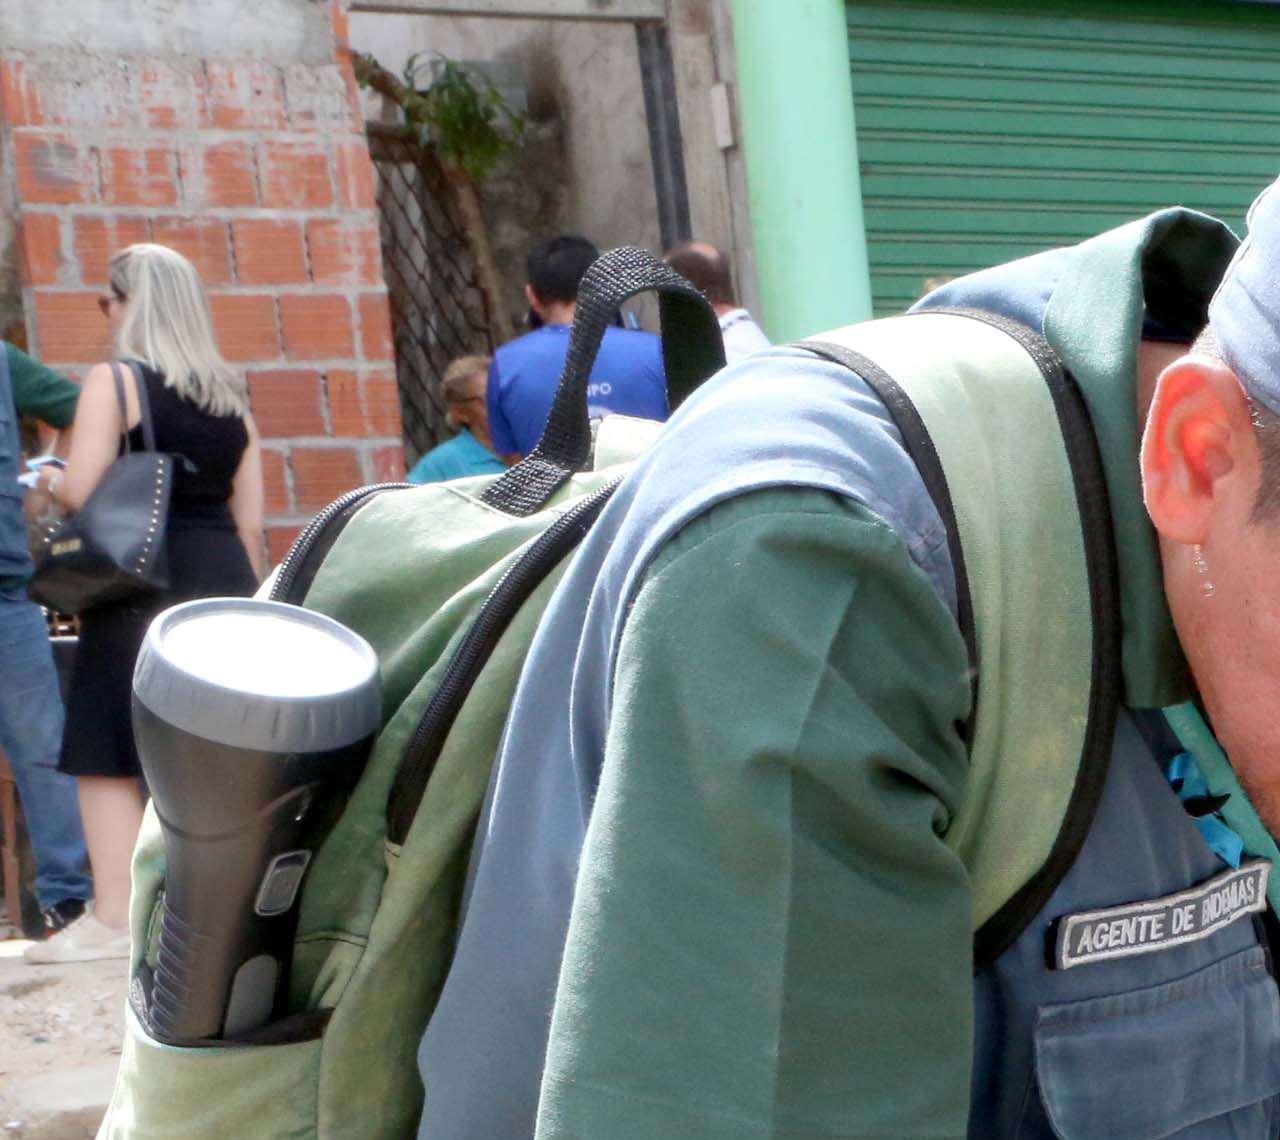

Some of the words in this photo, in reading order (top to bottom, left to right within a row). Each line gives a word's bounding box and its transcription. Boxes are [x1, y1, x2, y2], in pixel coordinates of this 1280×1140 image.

[1076, 912, 1167, 955] AGENTE
[1171, 905, 1195, 934] DE
[1201, 876, 1256, 928] ENDEMIAS
